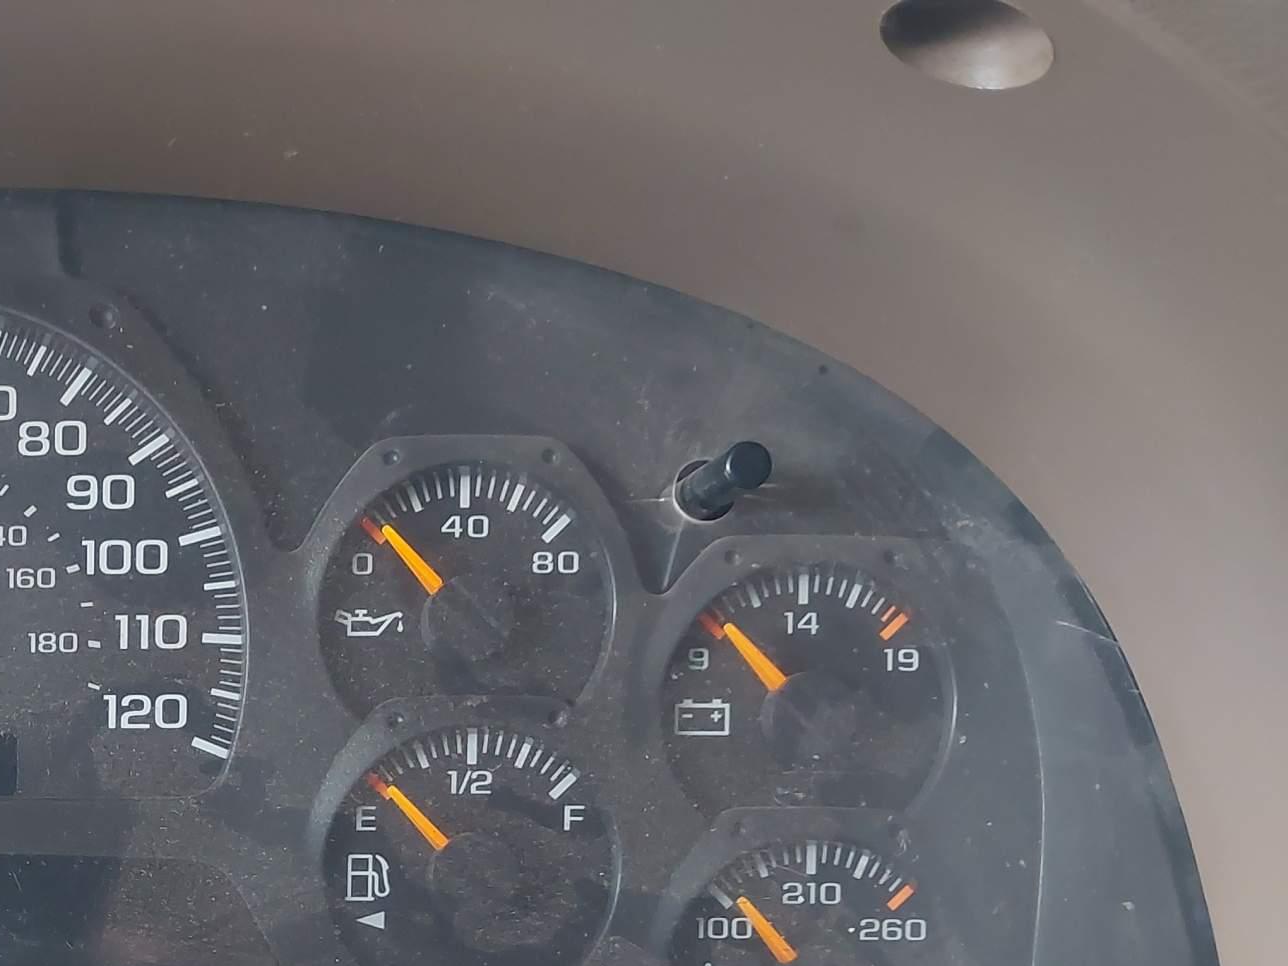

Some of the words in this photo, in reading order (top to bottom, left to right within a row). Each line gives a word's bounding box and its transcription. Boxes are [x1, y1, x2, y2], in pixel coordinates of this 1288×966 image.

[18, 421, 86, 456] 80
[67, 475, 134, 509] 90
[442, 516, 488, 537] 40
[82, 540, 167, 574] 100
[353, 554, 372, 574] 0
[533, 552, 578, 573] 80
[7, 568, 55, 588] 160
[115, 615, 187, 649] 110
[784, 612, 819, 634] 14
[28, 633, 77, 652] 180
[691, 649, 708, 670] 9
[884, 649, 918, 671] 19
[104, 695, 187, 728] 120
[448, 771, 492, 794] 1/2
[357, 806, 376, 830] E
[564, 806, 585, 830] F
[783, 883, 840, 904] 210
[699, 918, 752, 938] 100
[860, 919, 926, 940] 260
